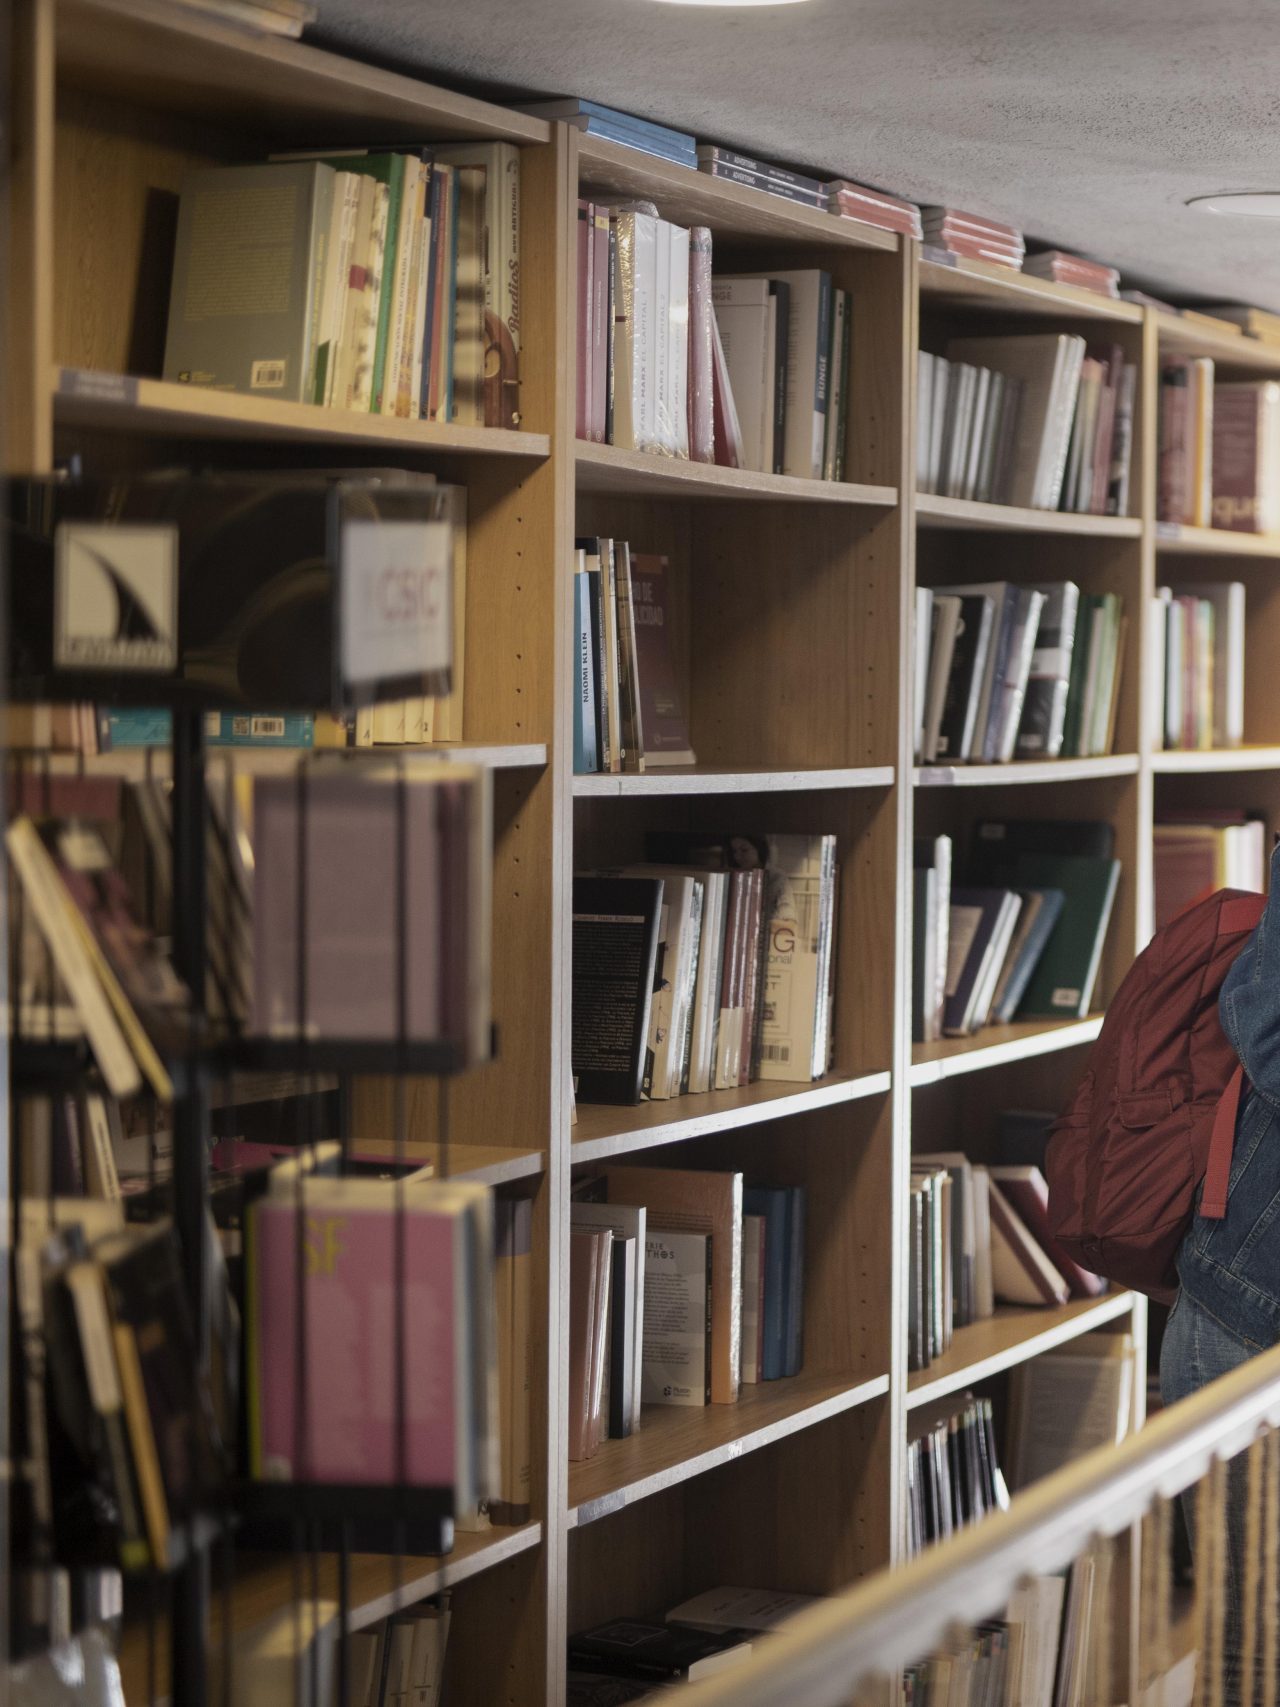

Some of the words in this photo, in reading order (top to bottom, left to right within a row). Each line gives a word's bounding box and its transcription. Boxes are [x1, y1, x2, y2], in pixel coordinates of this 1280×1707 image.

[641, 350, 647, 362] EL
[818, 356, 828, 400] BUNGE
[645, 1241, 664, 1250] ERIE
[647, 1250, 675, 1260] THOS
